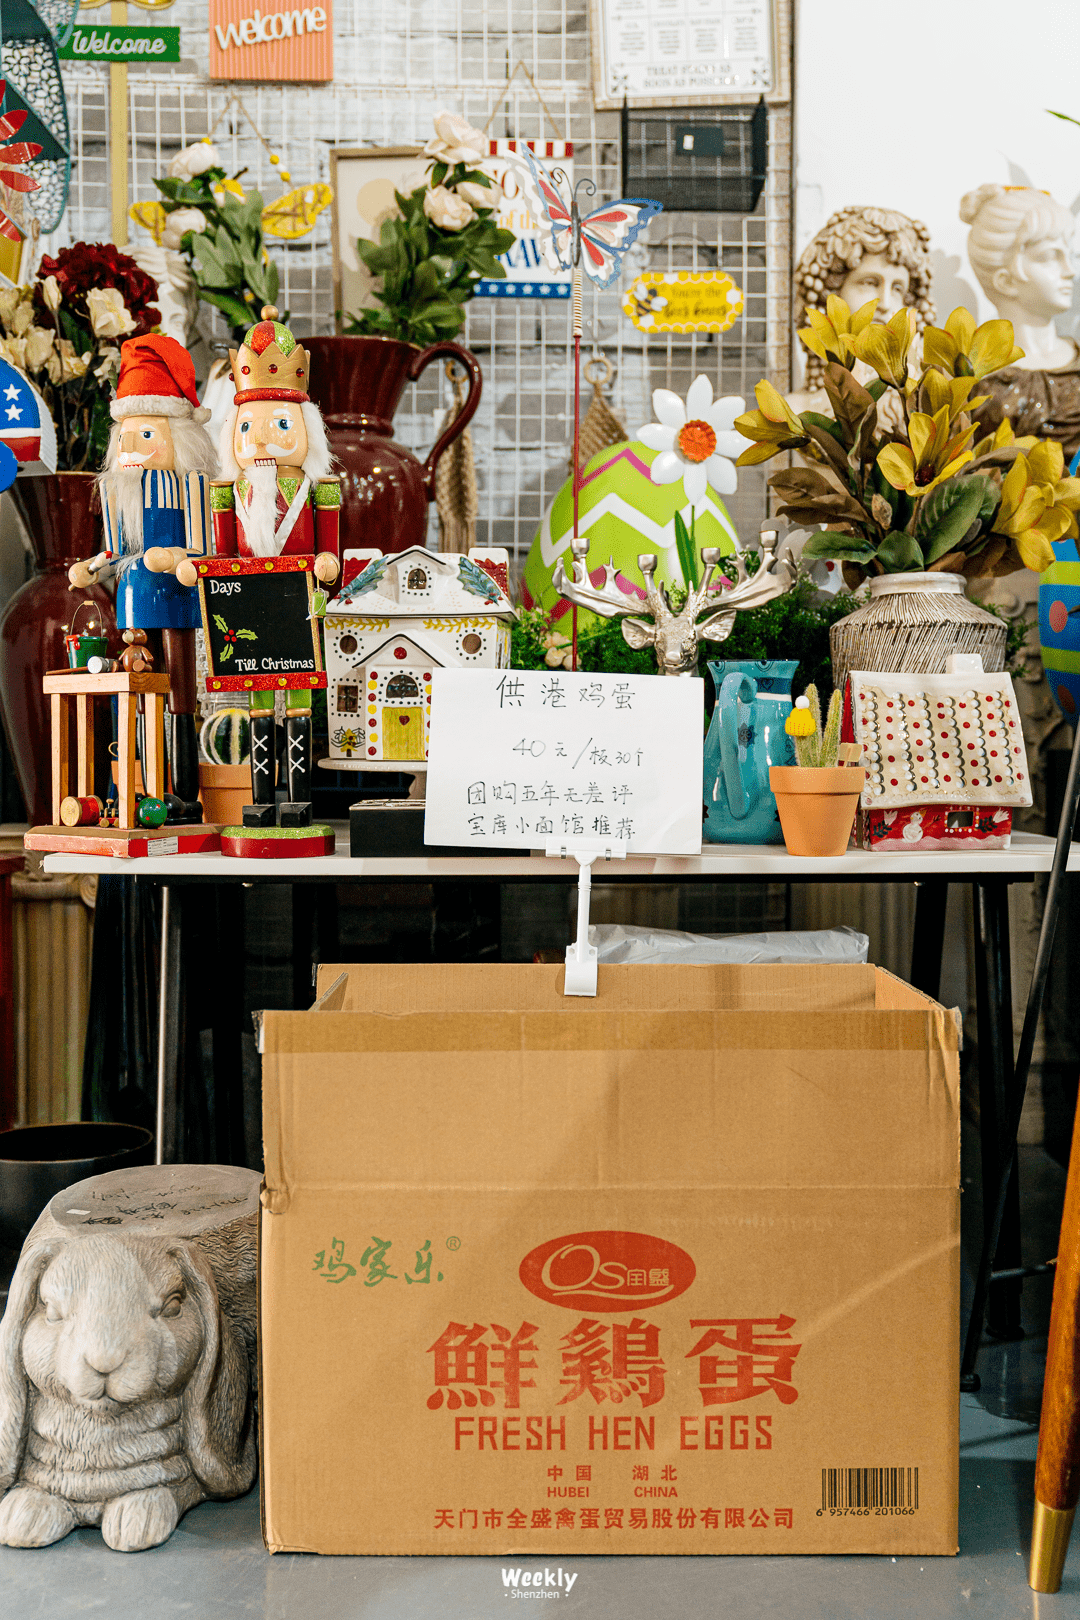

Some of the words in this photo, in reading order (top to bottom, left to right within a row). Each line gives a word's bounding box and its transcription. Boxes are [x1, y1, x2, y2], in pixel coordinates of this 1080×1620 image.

[215, 6, 328, 50] welcome
[72, 30, 167, 55] Welcome
[209, 580, 242, 596] Days
[235, 659, 259, 672] Till
[261, 657, 314, 670] Christmas
[496, 675, 636, 709] 供港鸡蛋
[467, 780, 634, 806] 团购五年无差评
[467, 812, 636, 839] 宝库小面馆推荐
[454, 1416, 566, 1451] FRESH
[588, 1416, 656, 1451] HEN
[680, 1415, 773, 1451] EGGS
[547, 1464, 592, 1481] 中国
[632, 1464, 677, 1481] 湖北
[547, 1486, 590, 1498] HUBEI
[633, 1486, 678, 1498] CHINA
[434, 1507, 794, 1530] 天门市全盛禽蛋贸易股份有限公司
[829, 1507, 870, 1517] 957466
[874, 1506, 915, 1516] 201066
